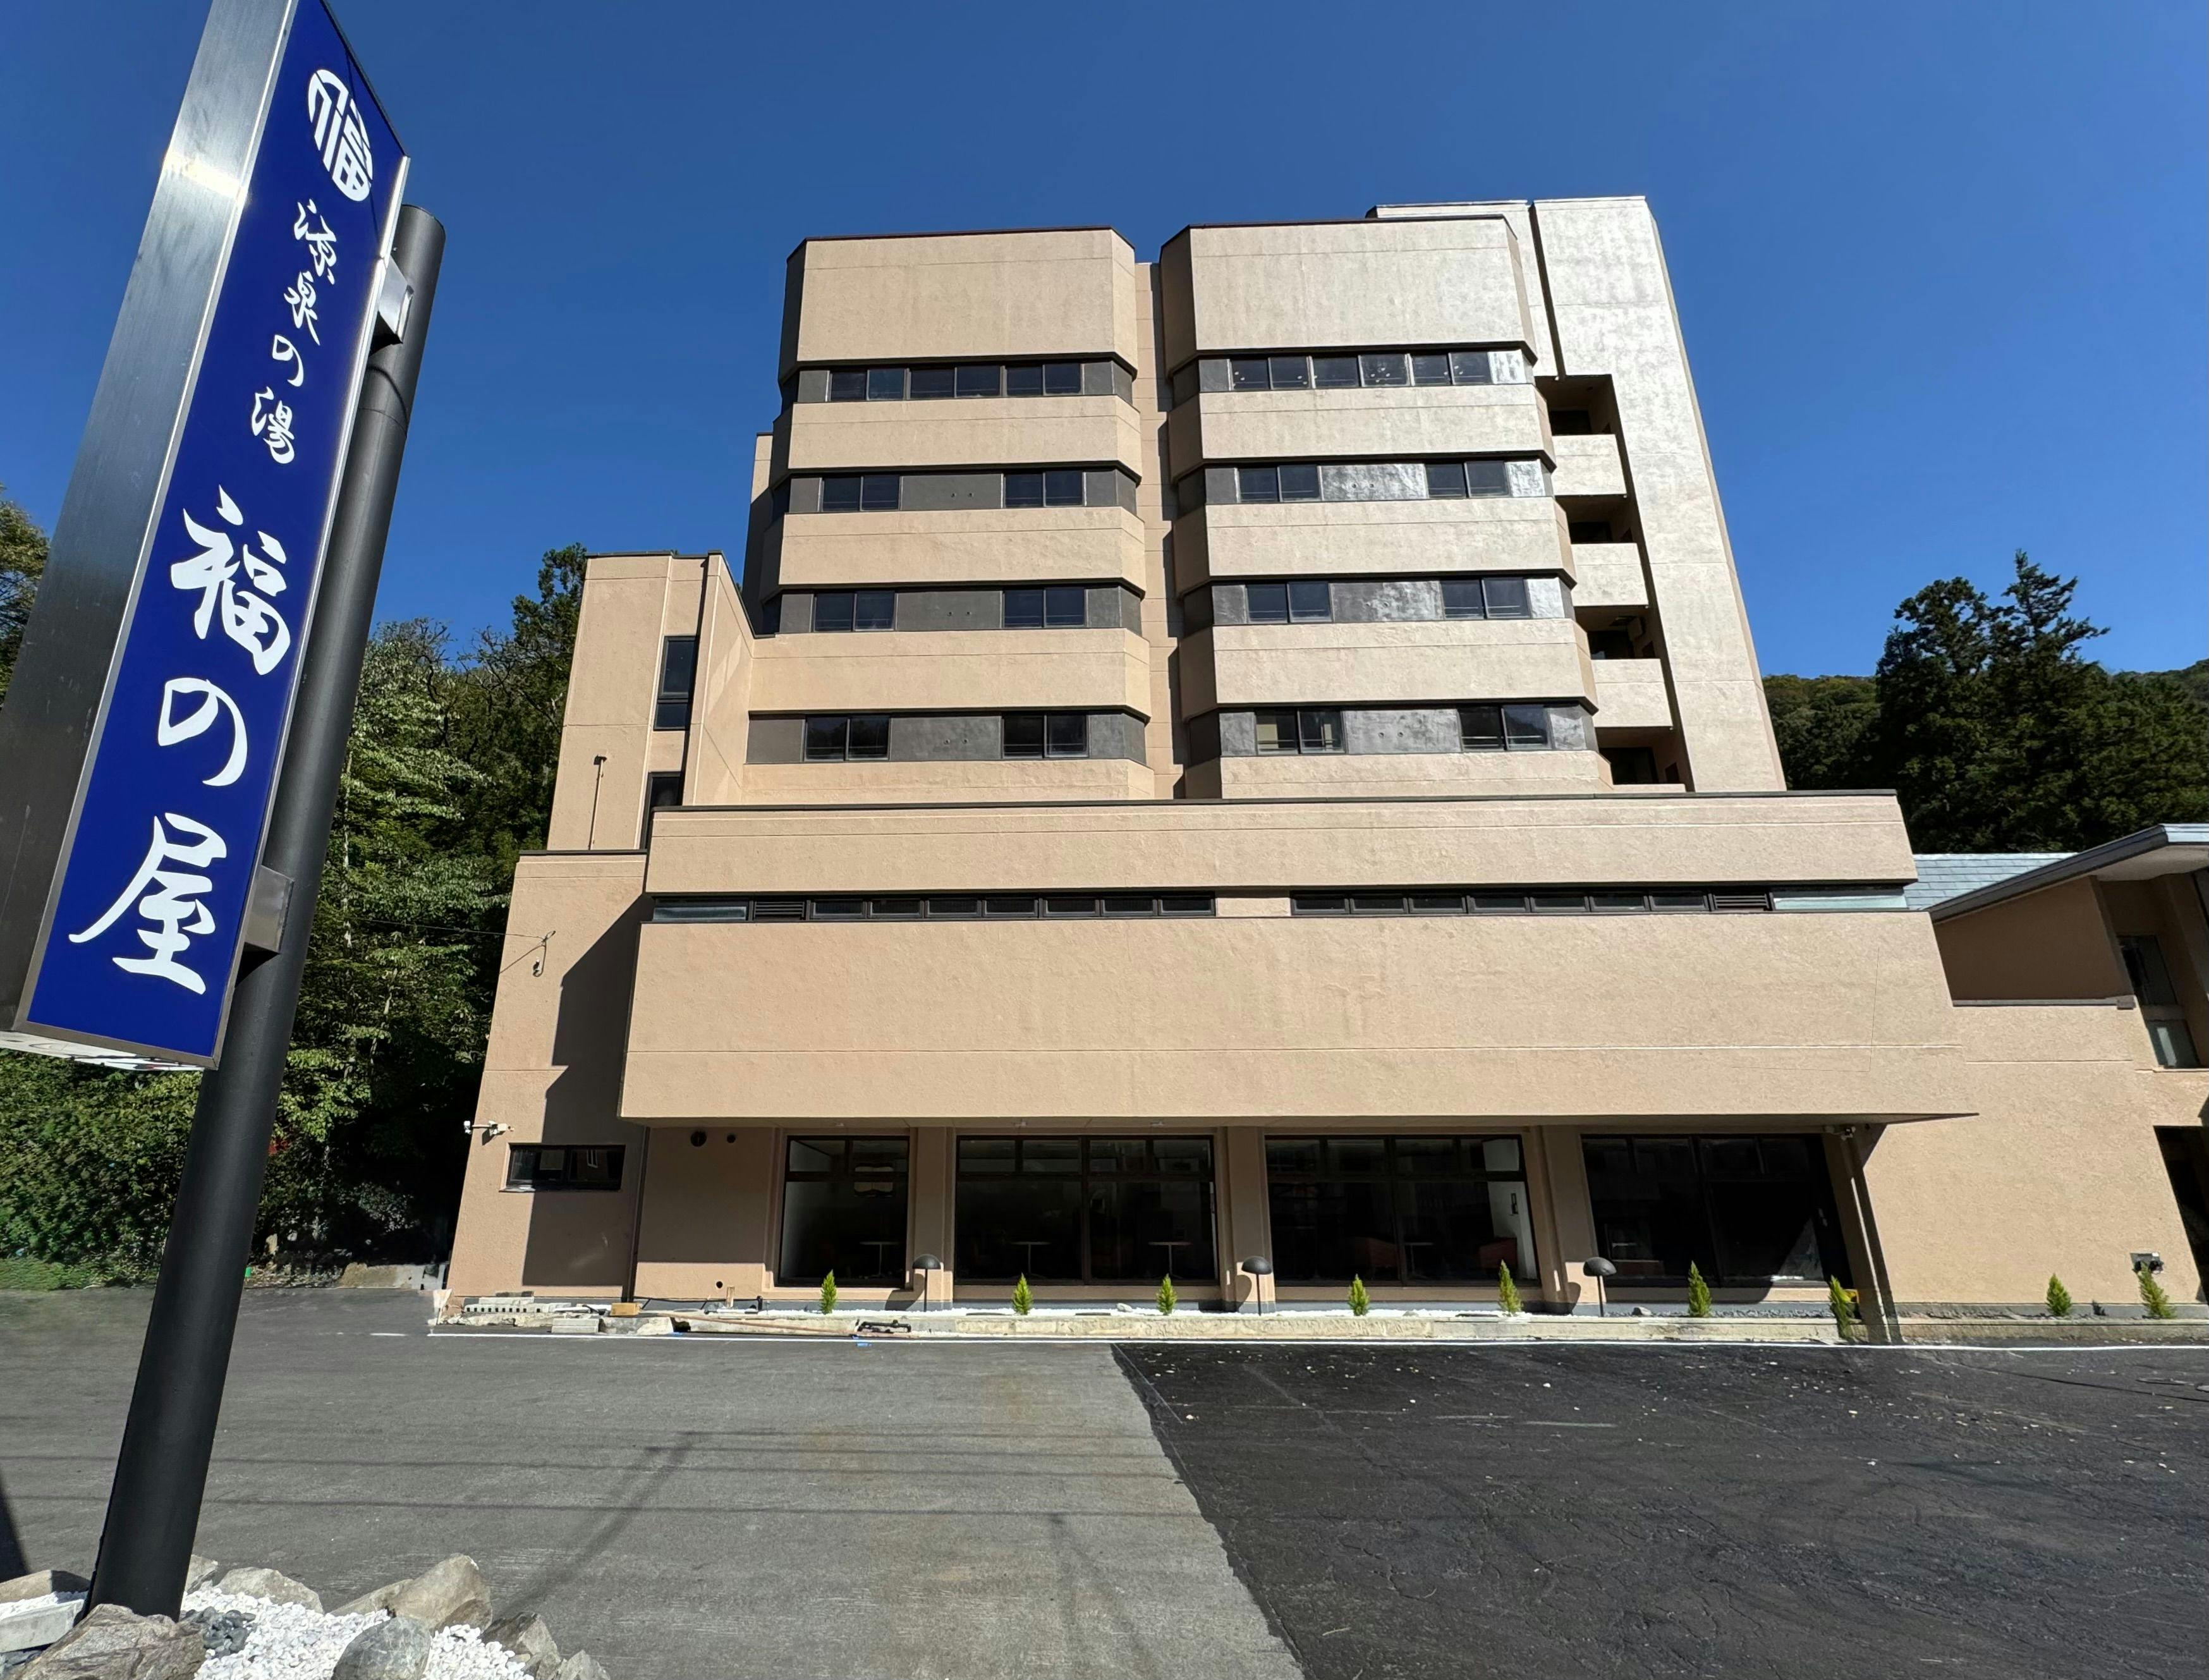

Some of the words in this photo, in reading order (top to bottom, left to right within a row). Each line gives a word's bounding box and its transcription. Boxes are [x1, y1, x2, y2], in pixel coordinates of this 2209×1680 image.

[251, 198, 338, 465] 源泉の湯
[68, 484, 291, 995] 福の屋
